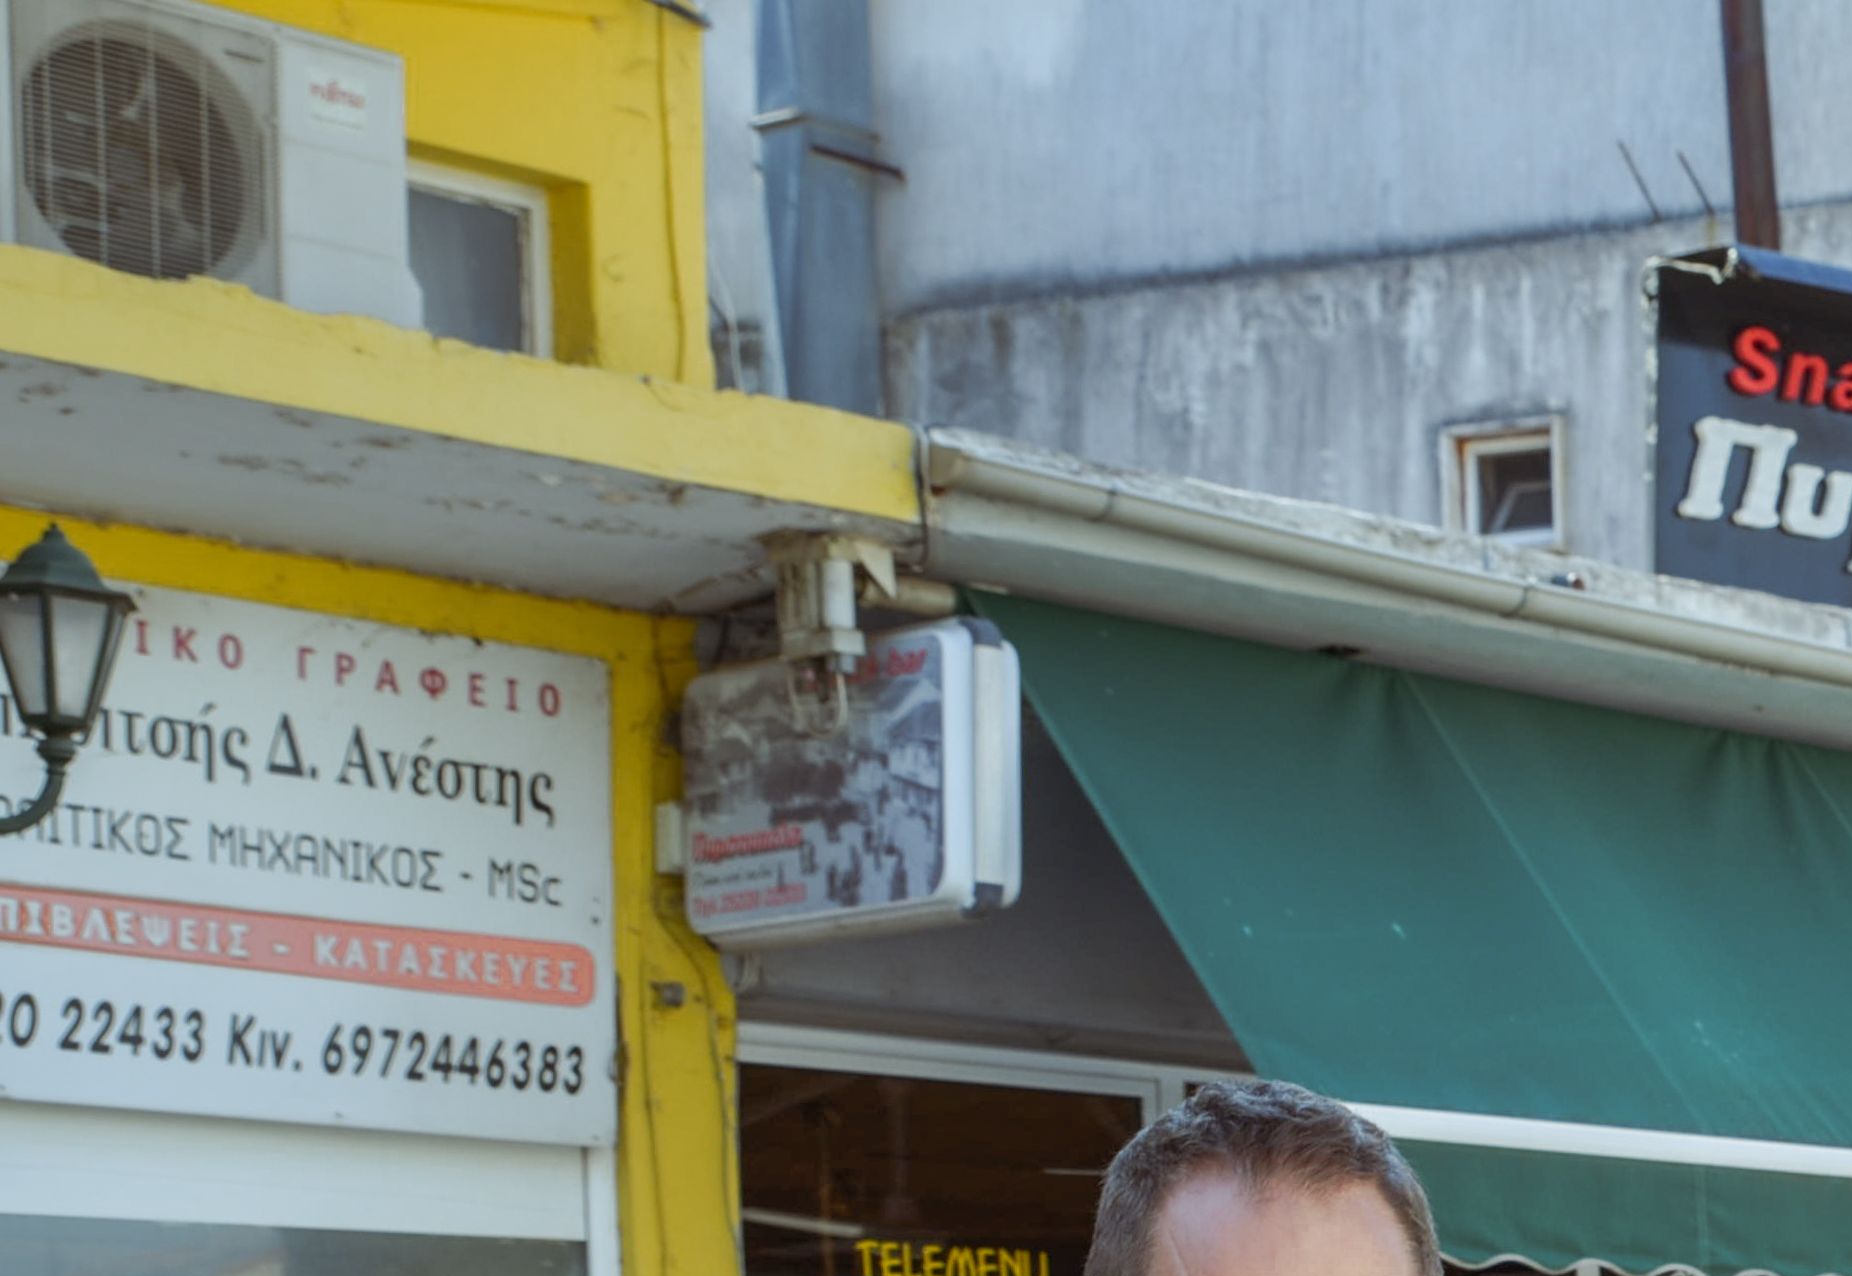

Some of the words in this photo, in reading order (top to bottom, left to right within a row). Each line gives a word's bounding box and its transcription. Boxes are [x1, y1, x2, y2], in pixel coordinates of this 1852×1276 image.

[296, 647, 562, 717] ΓΡΑΦΕΙΟ
[266, 713, 318, 781] Δ.
[336, 725, 556, 829] Ανέστης
[208, 821, 443, 893] ΜΗΧΑΝΙΚΟΣ
[488, 861, 562, 906] MSc
[314, 934, 579, 993] ΚΑΤΑΣΚΕΥΕΣ
[59, 998, 205, 1062] 22433
[227, 1014, 303, 1071] Κιν.
[322, 1024, 585, 1095] 6972446383
